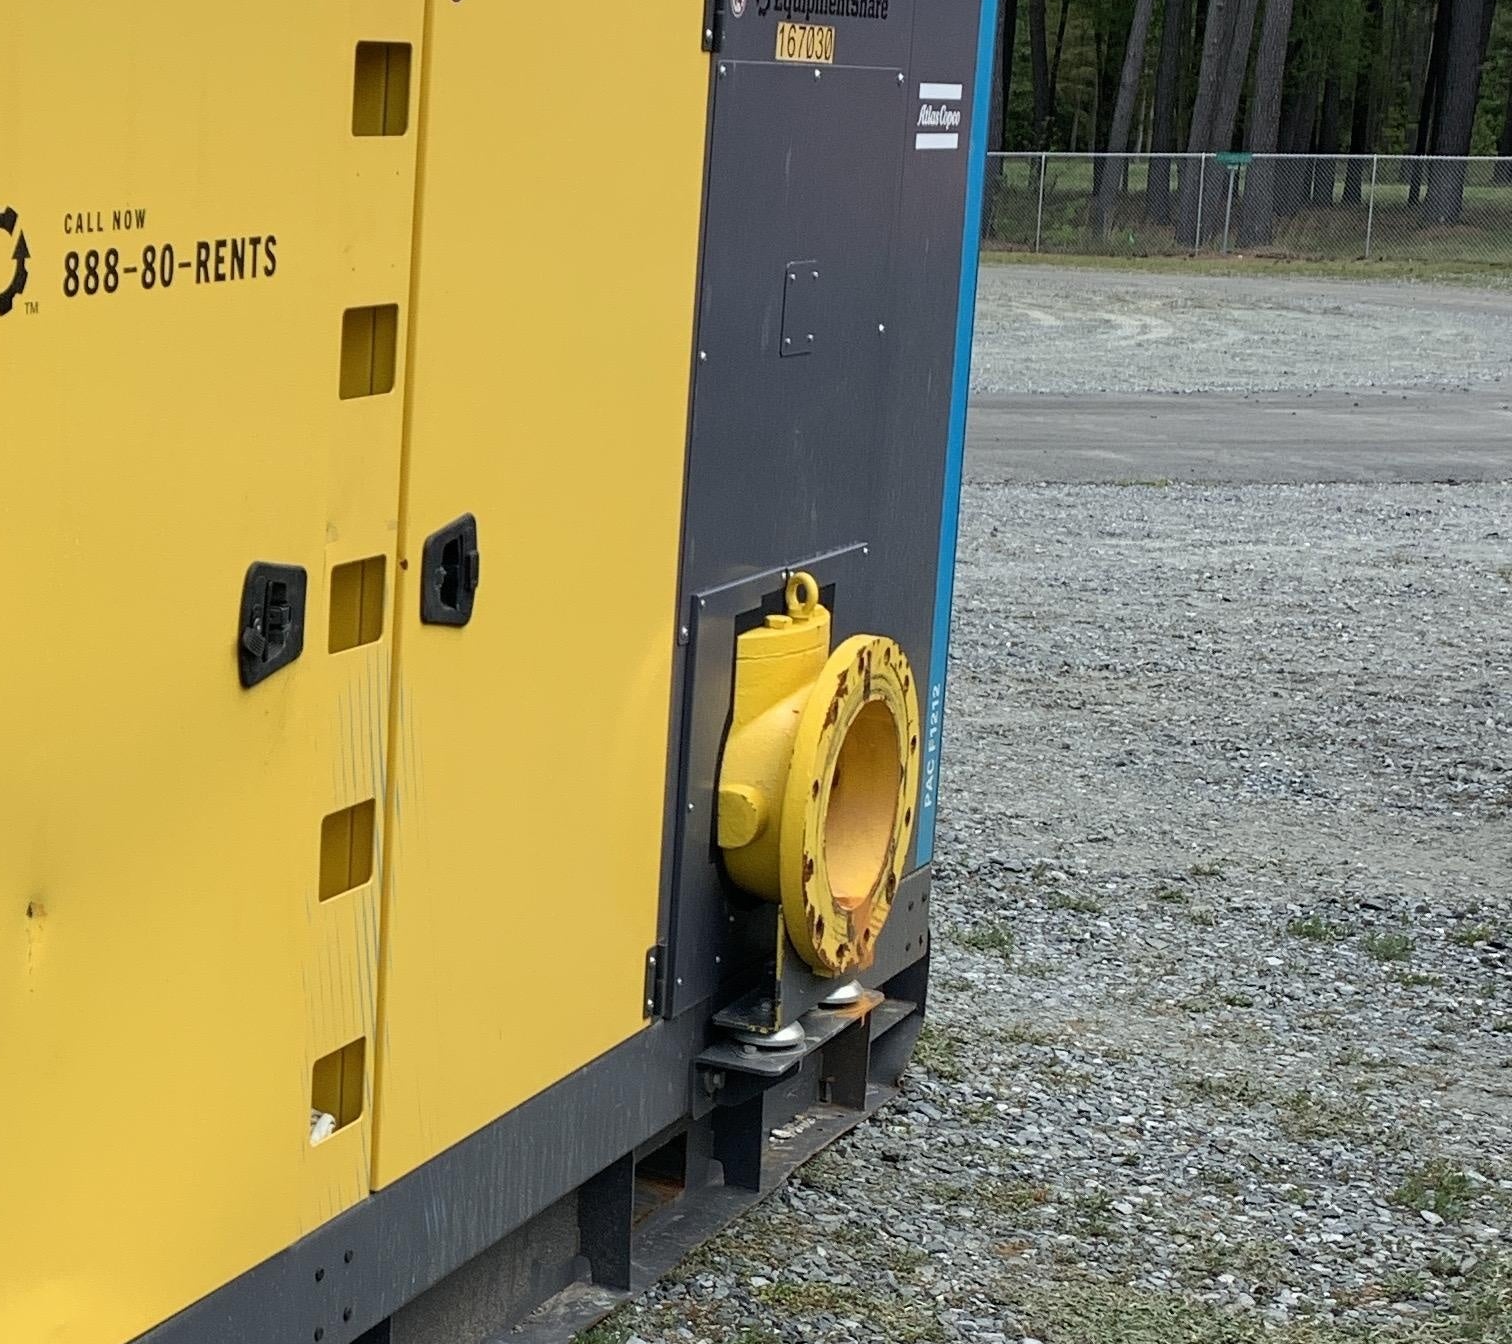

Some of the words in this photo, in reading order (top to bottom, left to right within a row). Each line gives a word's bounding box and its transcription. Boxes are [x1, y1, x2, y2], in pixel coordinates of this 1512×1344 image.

[778, 23, 834, 61] 167030
[64, 212, 104, 235] CALL
[112, 209, 147, 231] NOW
[62, 234, 278, 298] 888-80-RENTS
[923, 759, 936, 809] PAC
